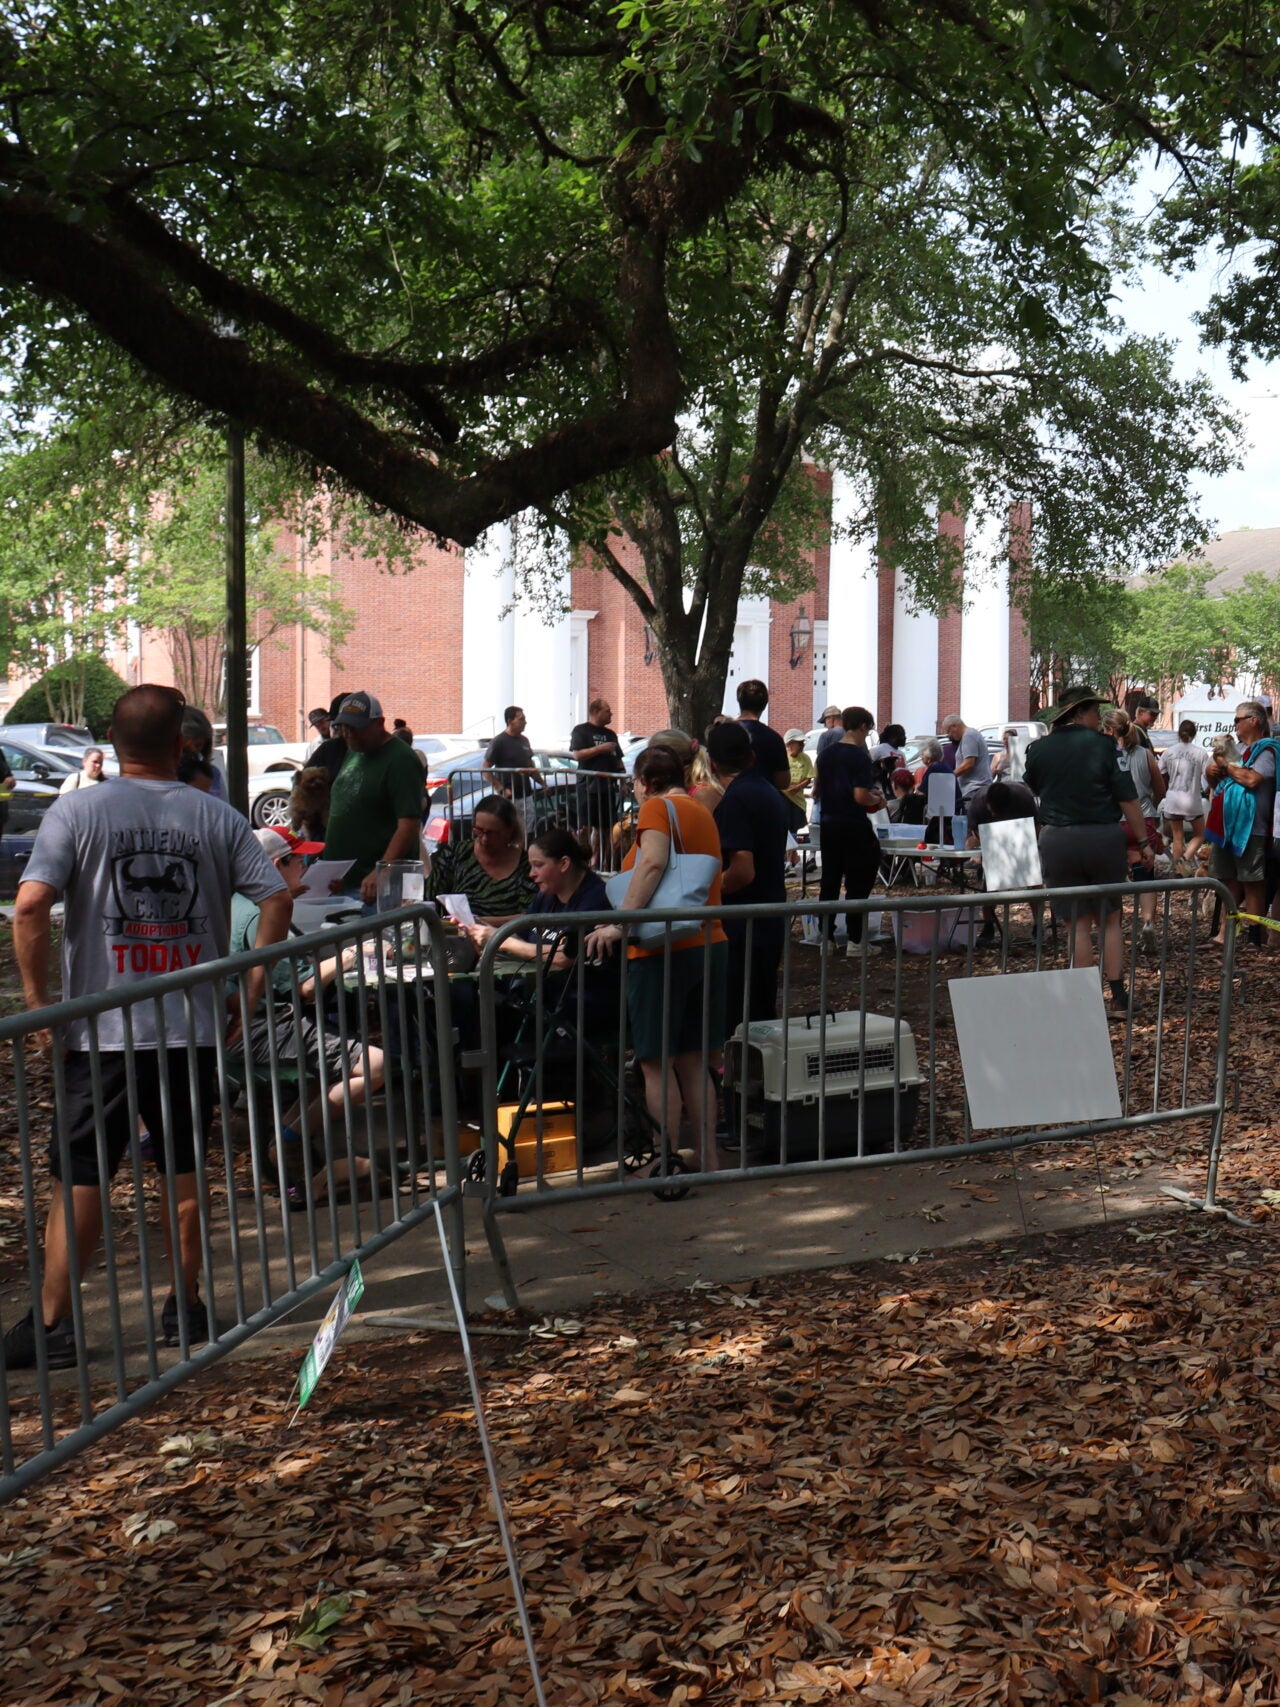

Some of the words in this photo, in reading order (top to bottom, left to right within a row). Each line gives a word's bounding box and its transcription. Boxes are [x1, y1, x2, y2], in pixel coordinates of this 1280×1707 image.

[1194, 722, 1212, 732] irst
[111, 828, 200, 857] KITTENS
[134, 897, 180, 919] CATS
[125, 922, 187, 936] ADOPTIONS
[112, 943, 202, 974] TODAY
